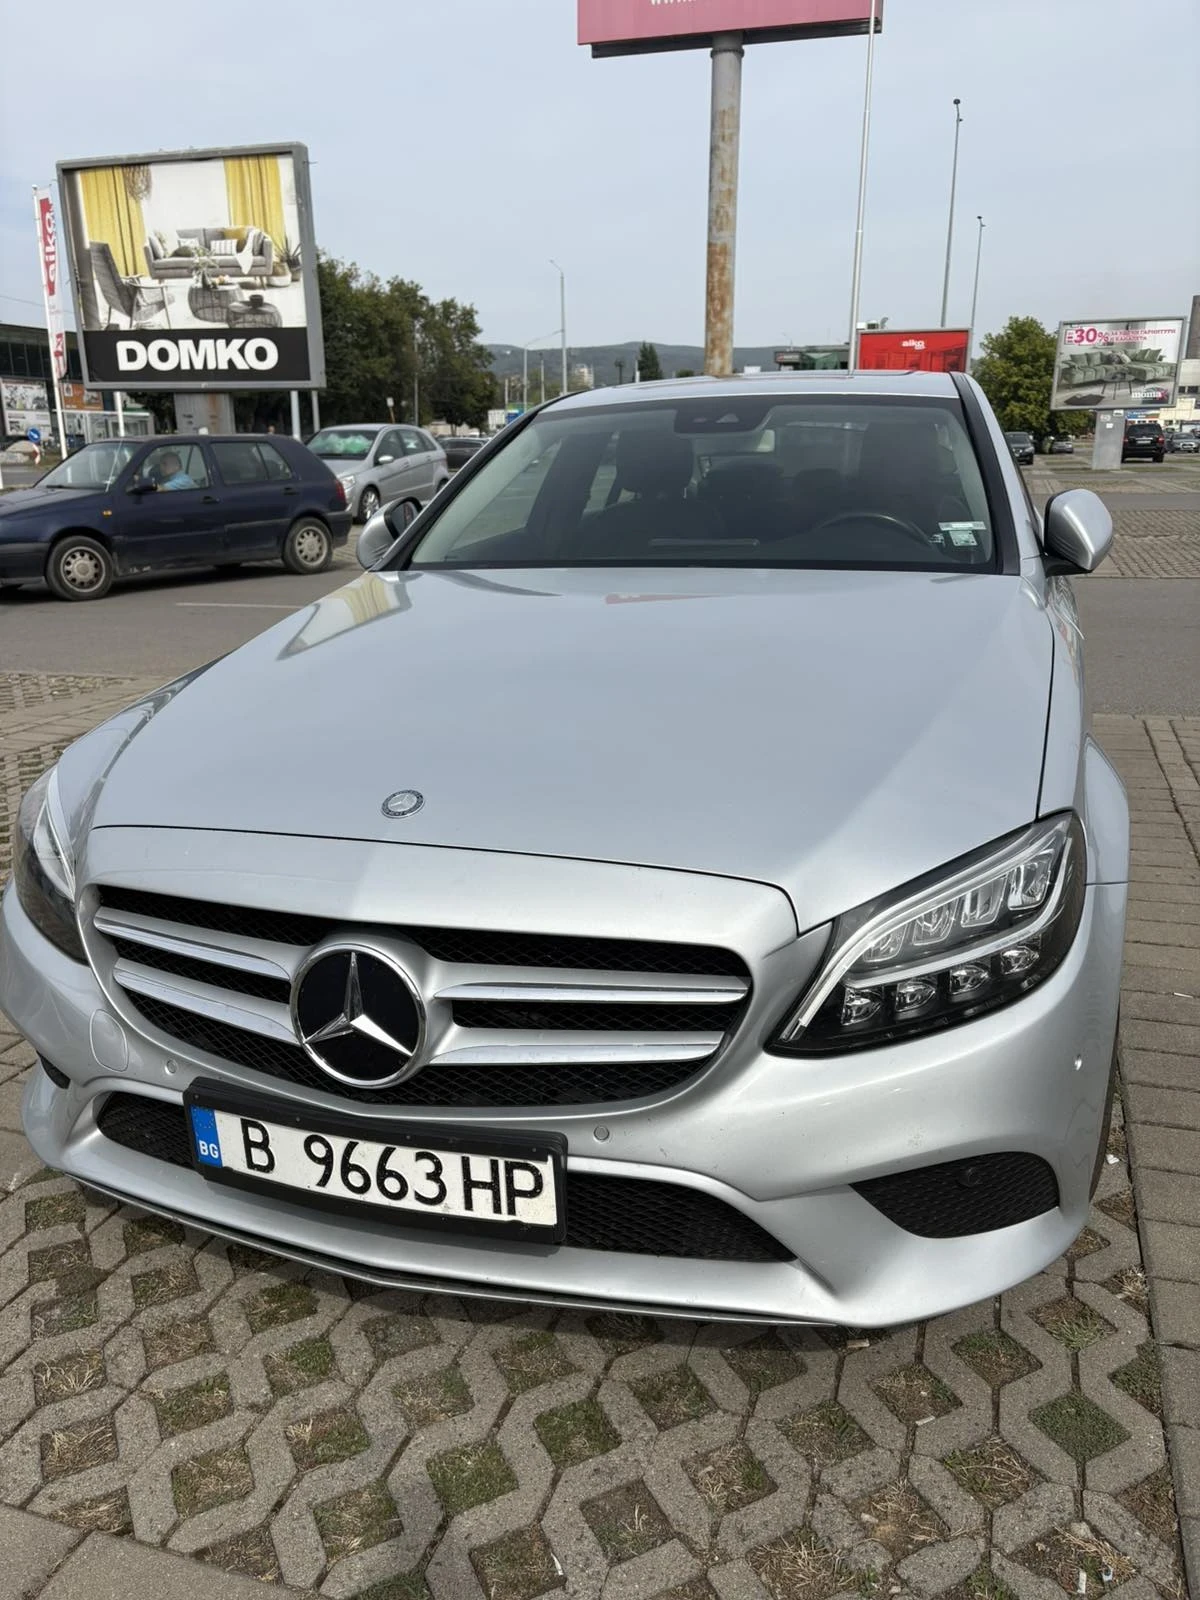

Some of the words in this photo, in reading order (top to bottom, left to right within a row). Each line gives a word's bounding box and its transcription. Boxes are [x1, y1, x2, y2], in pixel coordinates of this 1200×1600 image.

[115, 338, 279, 371] DOMKO
[198, 1140, 219, 1159] BG
[239, 1118, 275, 1173] B
[303, 1134, 447, 1206] 9663
